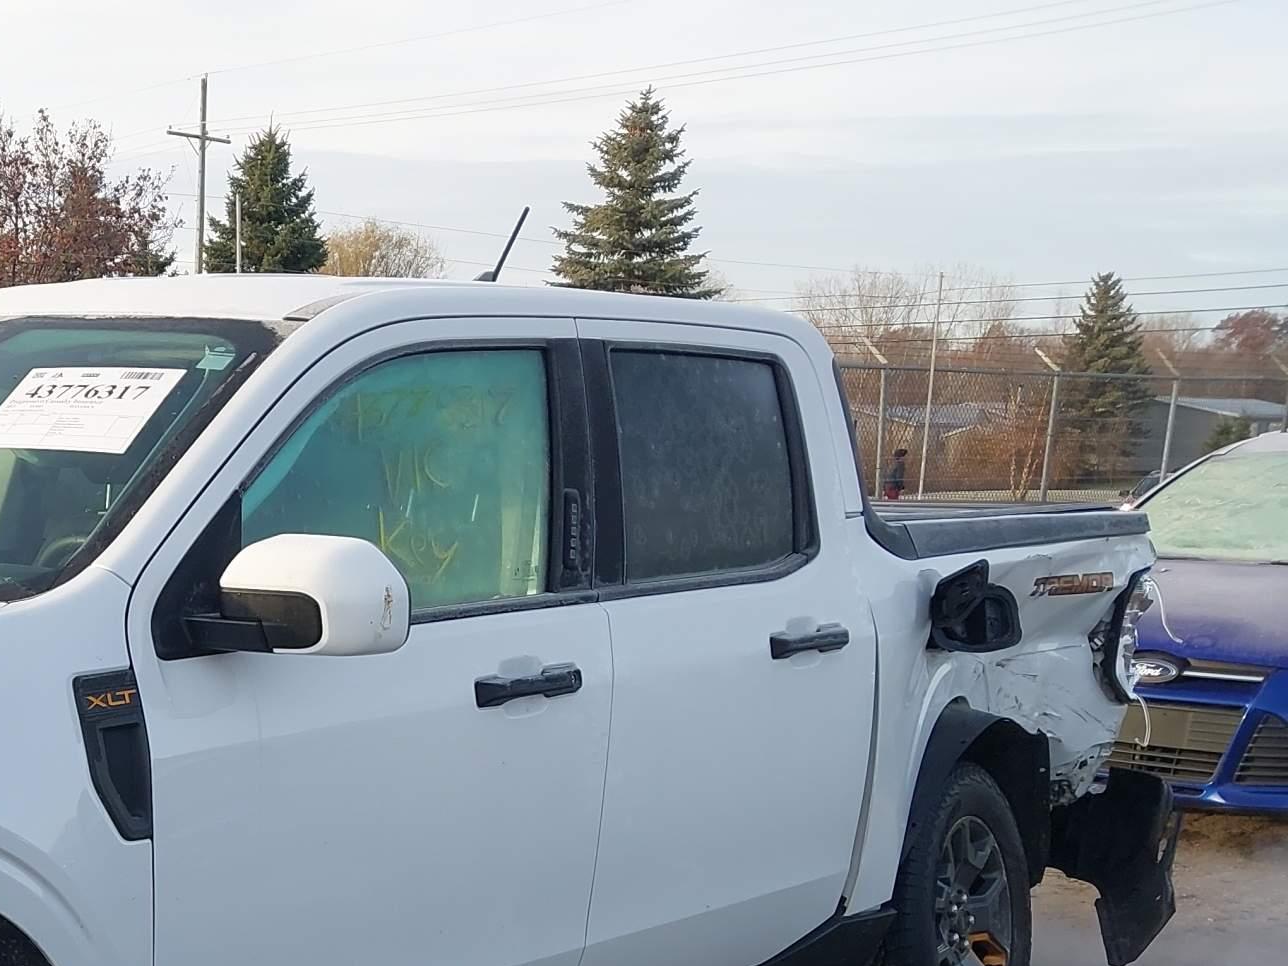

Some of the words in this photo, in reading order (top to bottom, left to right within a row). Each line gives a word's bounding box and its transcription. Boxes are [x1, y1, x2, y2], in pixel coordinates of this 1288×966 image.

[25, 384, 152, 400] 43776317
[1135, 662, 1164, 676] Ford
[85, 689, 137, 711] XLT
